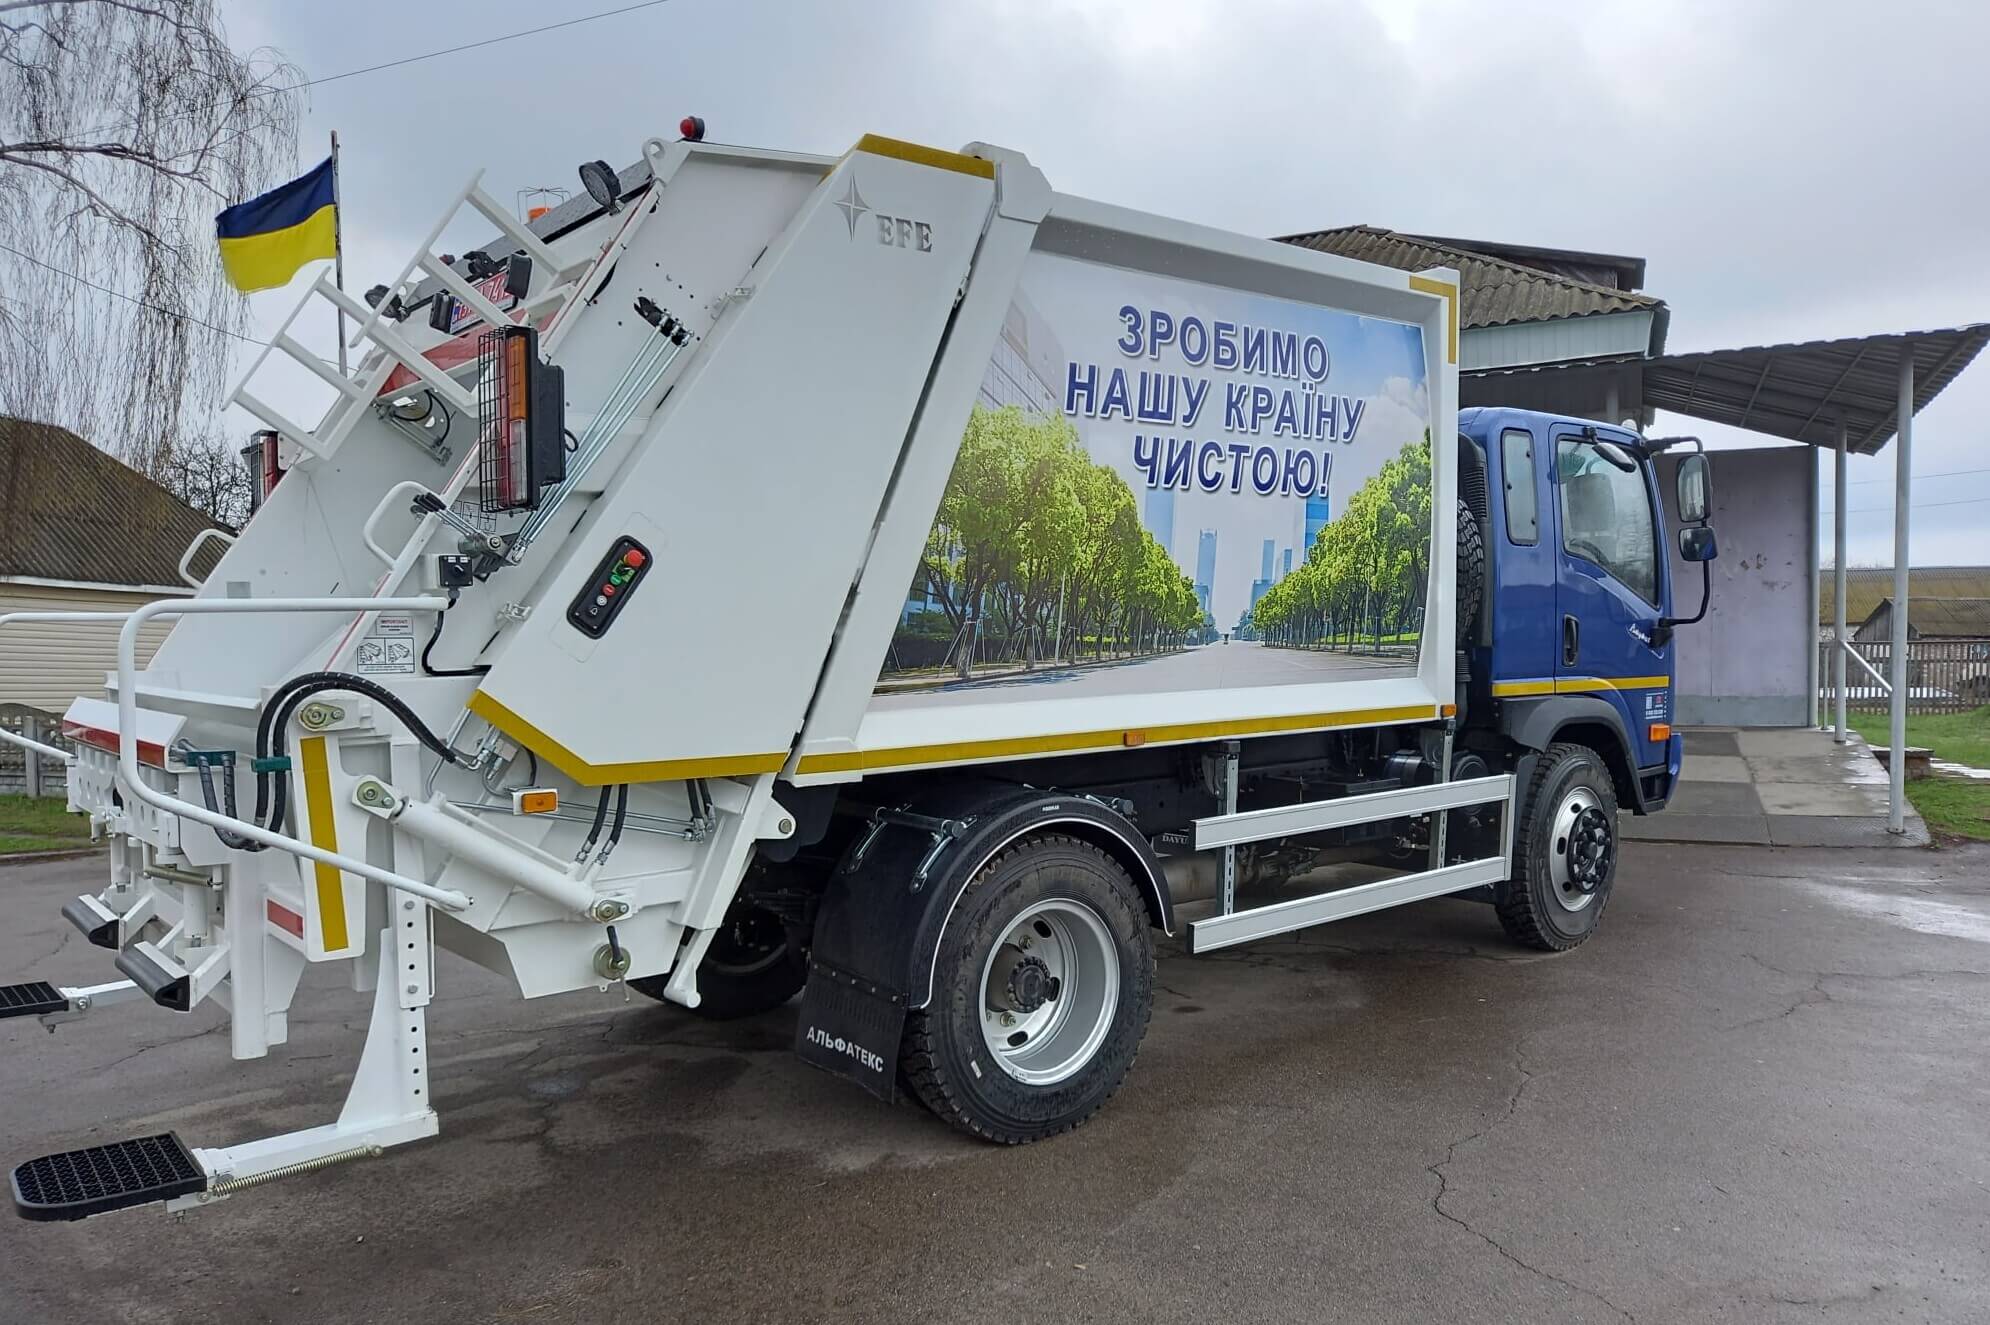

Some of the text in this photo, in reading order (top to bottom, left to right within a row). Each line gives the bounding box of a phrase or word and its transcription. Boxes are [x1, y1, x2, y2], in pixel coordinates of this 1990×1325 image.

[875, 214, 933, 253] EFE
[1117, 303, 1331, 383] ЗРОБИМО
[1063, 360, 1367, 444] НАШУ КРАЇНУ
[1133, 433, 1334, 499] ЧИСТОЮ!
[806, 1025, 884, 1073] АЛЬФАТЕКС
